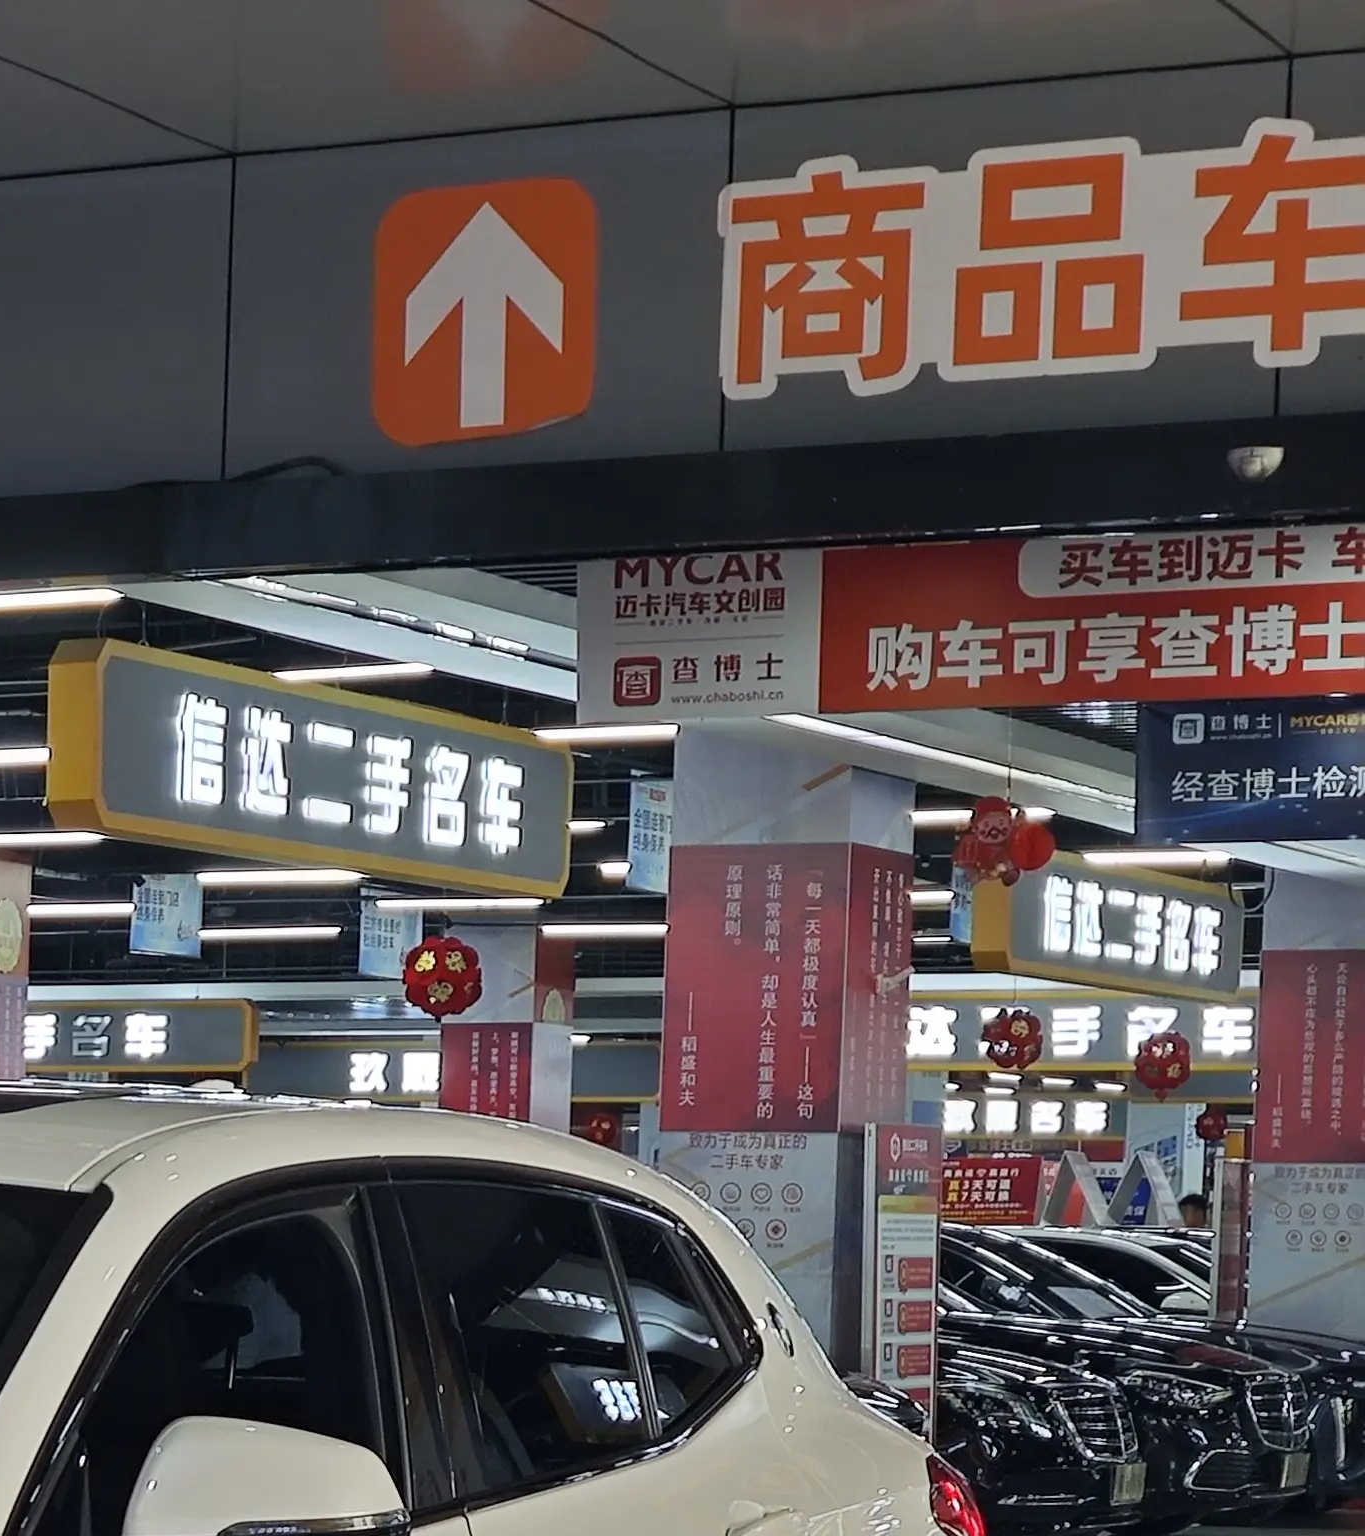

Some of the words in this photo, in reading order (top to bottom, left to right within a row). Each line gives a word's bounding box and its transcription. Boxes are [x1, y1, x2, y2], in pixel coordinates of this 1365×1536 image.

[724, 125, 1365, 392] 商品车
[614, 552, 783, 589] MYCAR
[1059, 530, 1305, 589] 买车到迈卡
[615, 587, 785, 619] 迈卡汽车文创园
[866, 601, 1365, 691] 购车可享查博士
[672, 652, 784, 685] 查博士
[671, 689, 784, 705] www.chaboshi.cn
[1211, 714, 1272, 731] 查博士
[175, 691, 525, 855] 信达二手名车
[1171, 765, 1365, 802] 经查博士检测
[1043, 873, 1224, 975] 信达二手名车
[688, 1132, 807, 1151] 致力于成为真正的
[709, 1153, 784, 1170] 二手车专家
